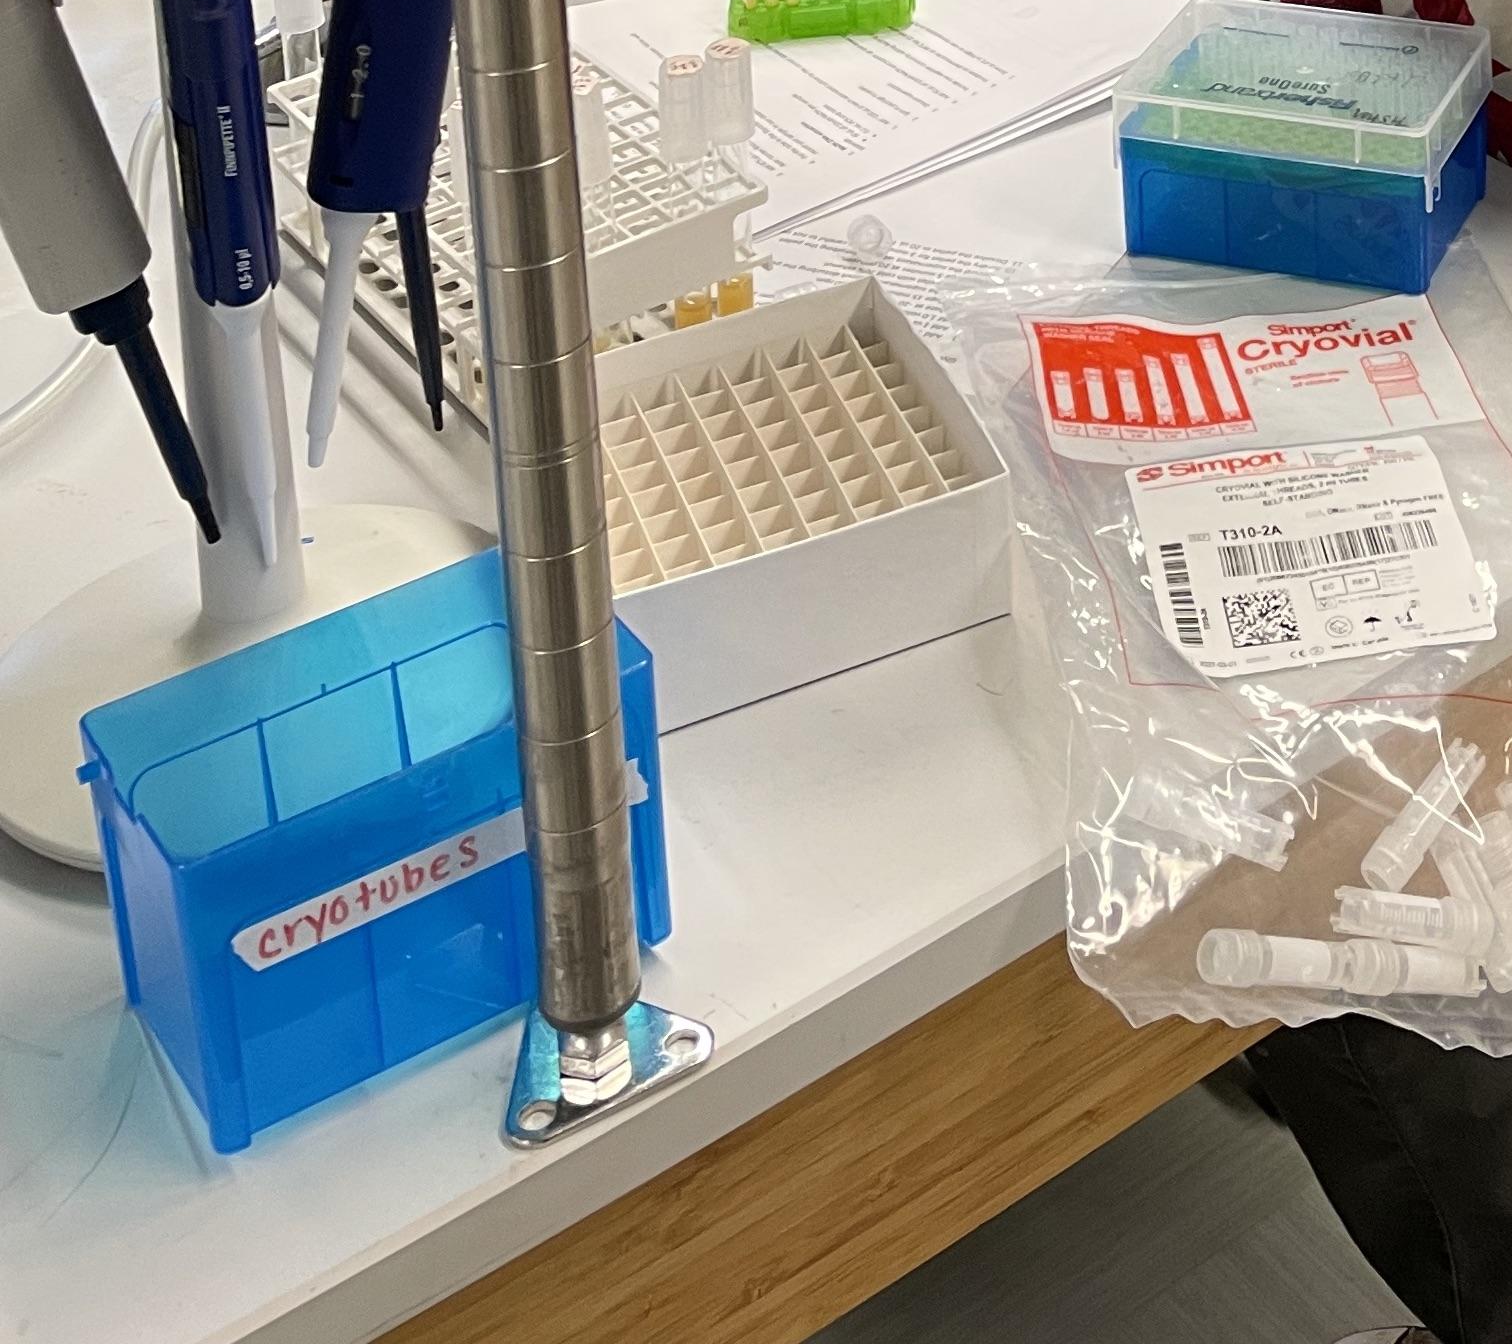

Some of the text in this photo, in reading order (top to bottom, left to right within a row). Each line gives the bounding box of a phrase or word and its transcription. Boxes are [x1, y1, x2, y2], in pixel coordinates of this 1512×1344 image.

[1201, 82, 1358, 110] Fisherbrand
[1258, 76, 1332, 95] SureOne
[1267, 320, 1353, 336] Simport
[1237, 322, 1413, 361] Cryovial
[1168, 451, 1286, 477] Simport
[1218, 525, 1282, 541] T310-2A
[258, 835, 480, 960] cryotubes
